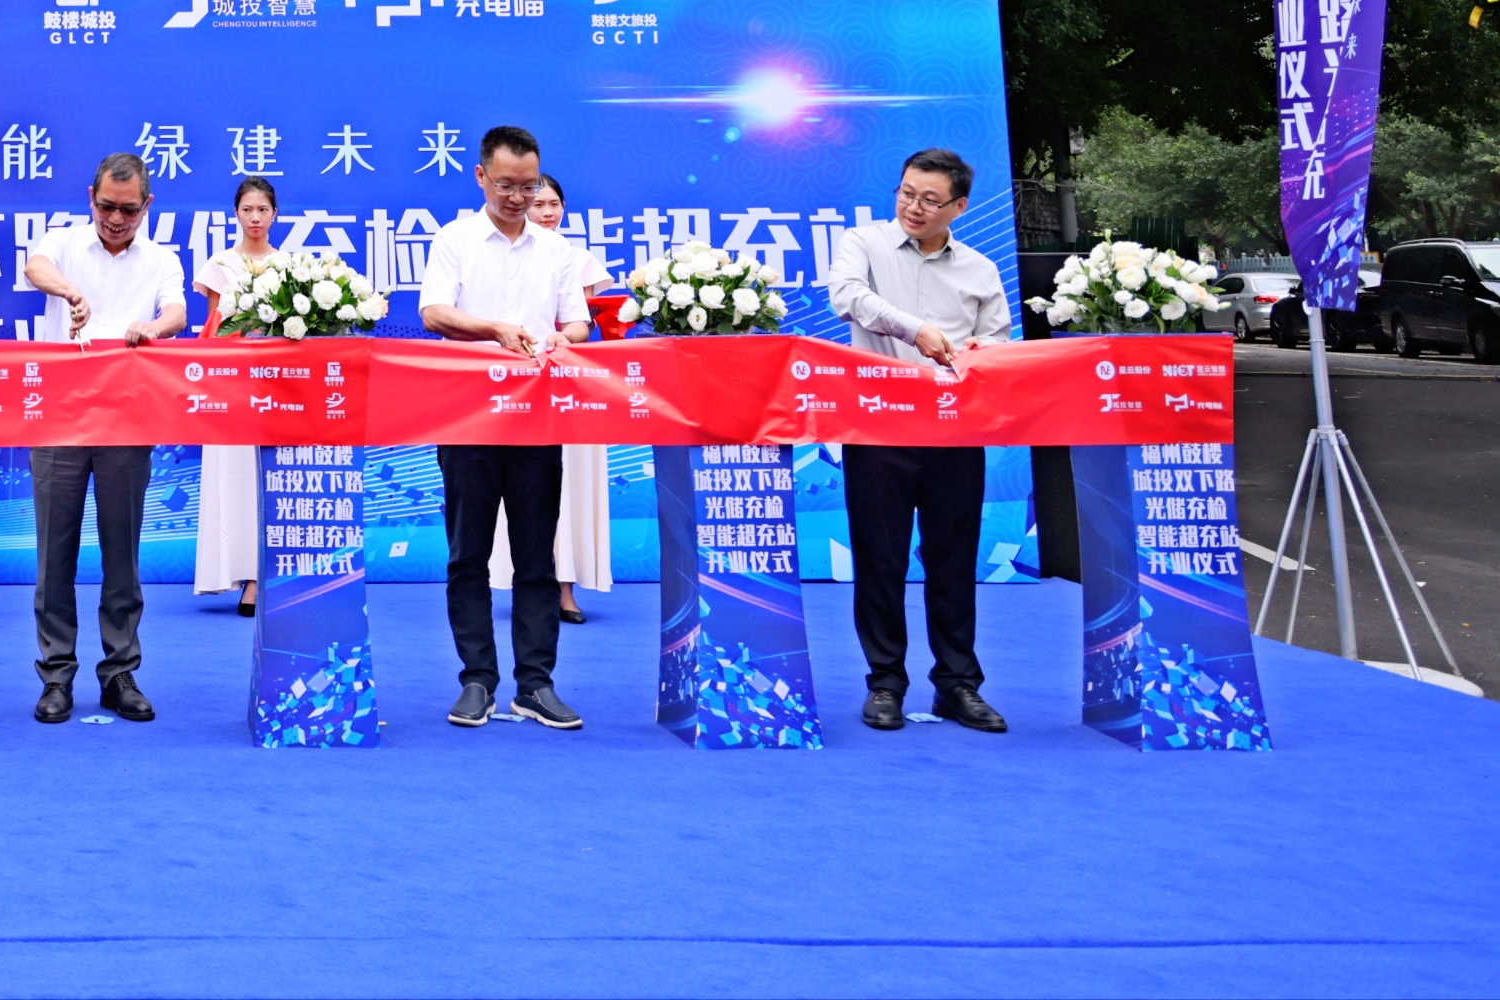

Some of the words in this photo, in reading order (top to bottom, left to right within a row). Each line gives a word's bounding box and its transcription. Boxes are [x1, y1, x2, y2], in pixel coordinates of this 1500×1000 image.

[43, 11, 117, 30] 鼓楼城投
[212, 20, 258, 28] CHENGTOU
[258, 20, 318, 28] INTELLIGENCE
[591, 13, 658, 28] 鼓楼文旅投
[49, 32, 110, 44] GLCT
[592, 30, 659, 45] GCTI
[134, 121, 466, 180] 绿建未来
[207, 368, 238, 376] 星云股份
[511, 368, 541, 376] 星云股份
[815, 367, 845, 375] 星云股份
[1119, 366, 1151, 375] 星云股份
[275, 446, 353, 466] 福州鼓楼
[702, 445, 780, 464] 福州鼓楼
[1141, 444, 1222, 464] 福州鼓楼
[266, 471, 363, 493] 城投双下路
[694, 468, 792, 491] 城投双下路
[1133, 470, 1235, 492] 城投双下路
[276, 498, 354, 521] 光储充检
[706, 496, 784, 520] 光储充检
[1146, 497, 1227, 520] 光储充检
[266, 525, 363, 548] 智能超充站
[697, 524, 795, 547] 智能超充站
[1137, 525, 1240, 549] 智能超充站
[276, 553, 355, 576] 开业仪式
[706, 550, 793, 574] 开业仪式
[1148, 552, 1238, 575] 开业仪式
